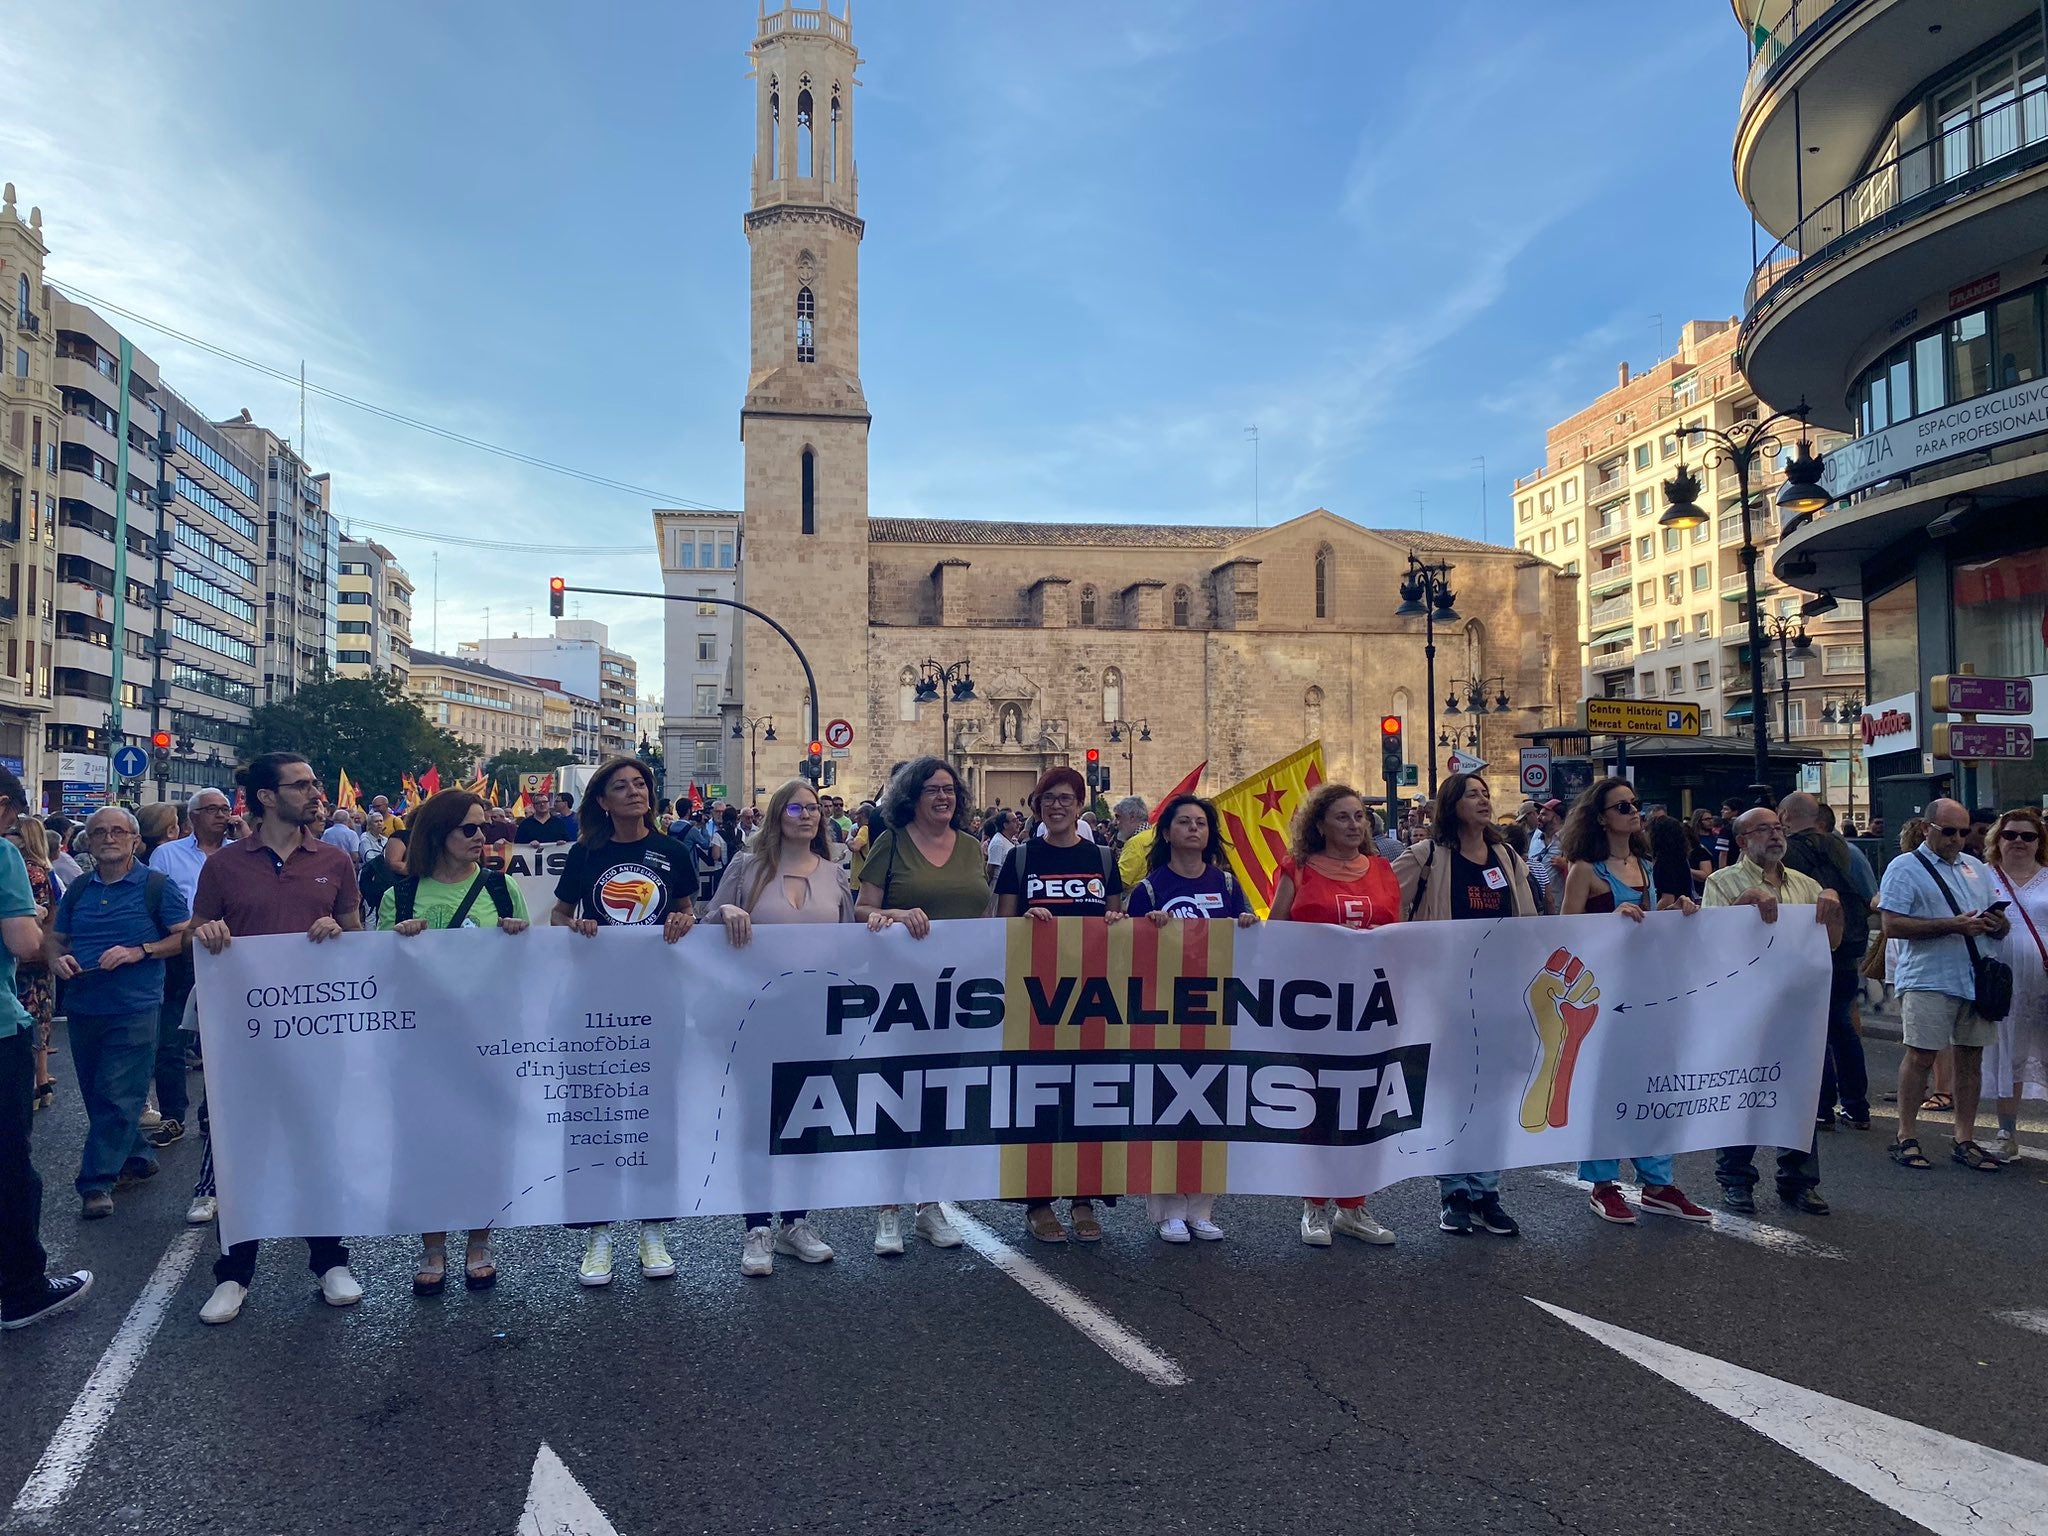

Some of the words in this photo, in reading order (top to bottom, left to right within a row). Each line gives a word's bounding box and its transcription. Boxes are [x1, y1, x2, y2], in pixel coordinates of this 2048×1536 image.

[1915, 439, 1948, 458] PARA
[1951, 407, 2048, 447] PROFESIONAL
[1918, 409, 1971, 437] ESPACIO
[1589, 703, 1621, 715] Centre
[1668, 711, 1679, 727] P
[1589, 718, 1622, 729] Mercat
[1627, 720, 1662, 731] Central
[1528, 772, 1543, 780] 30
[246, 975, 378, 1008] COMISSIÓ
[825, 967, 1006, 1036] PAÍS
[1023, 968, 1398, 1032] VALENCIÀ
[247, 1018, 261, 1039] 9
[274, 1010, 416, 1039] D'OCTUBRE
[585, 1013, 652, 1028] lliure
[477, 1035, 651, 1056] valencianofòbia
[516, 1060, 651, 1080] d'injustícies
[1646, 1061, 1782, 1093] MANIFESTACIÓ
[544, 1082, 649, 1100] LGTBfòbia
[779, 1061, 1413, 1140] ANTIFEIXISTA
[547, 1107, 650, 1123] masclisme
[1616, 1102, 1628, 1120] 9
[1635, 1094, 1731, 1120] D'OCTUBRE
[1737, 1090, 1777, 1109] 2023
[570, 1130, 649, 1145] racisme
[615, 1151, 648, 1167] odi
